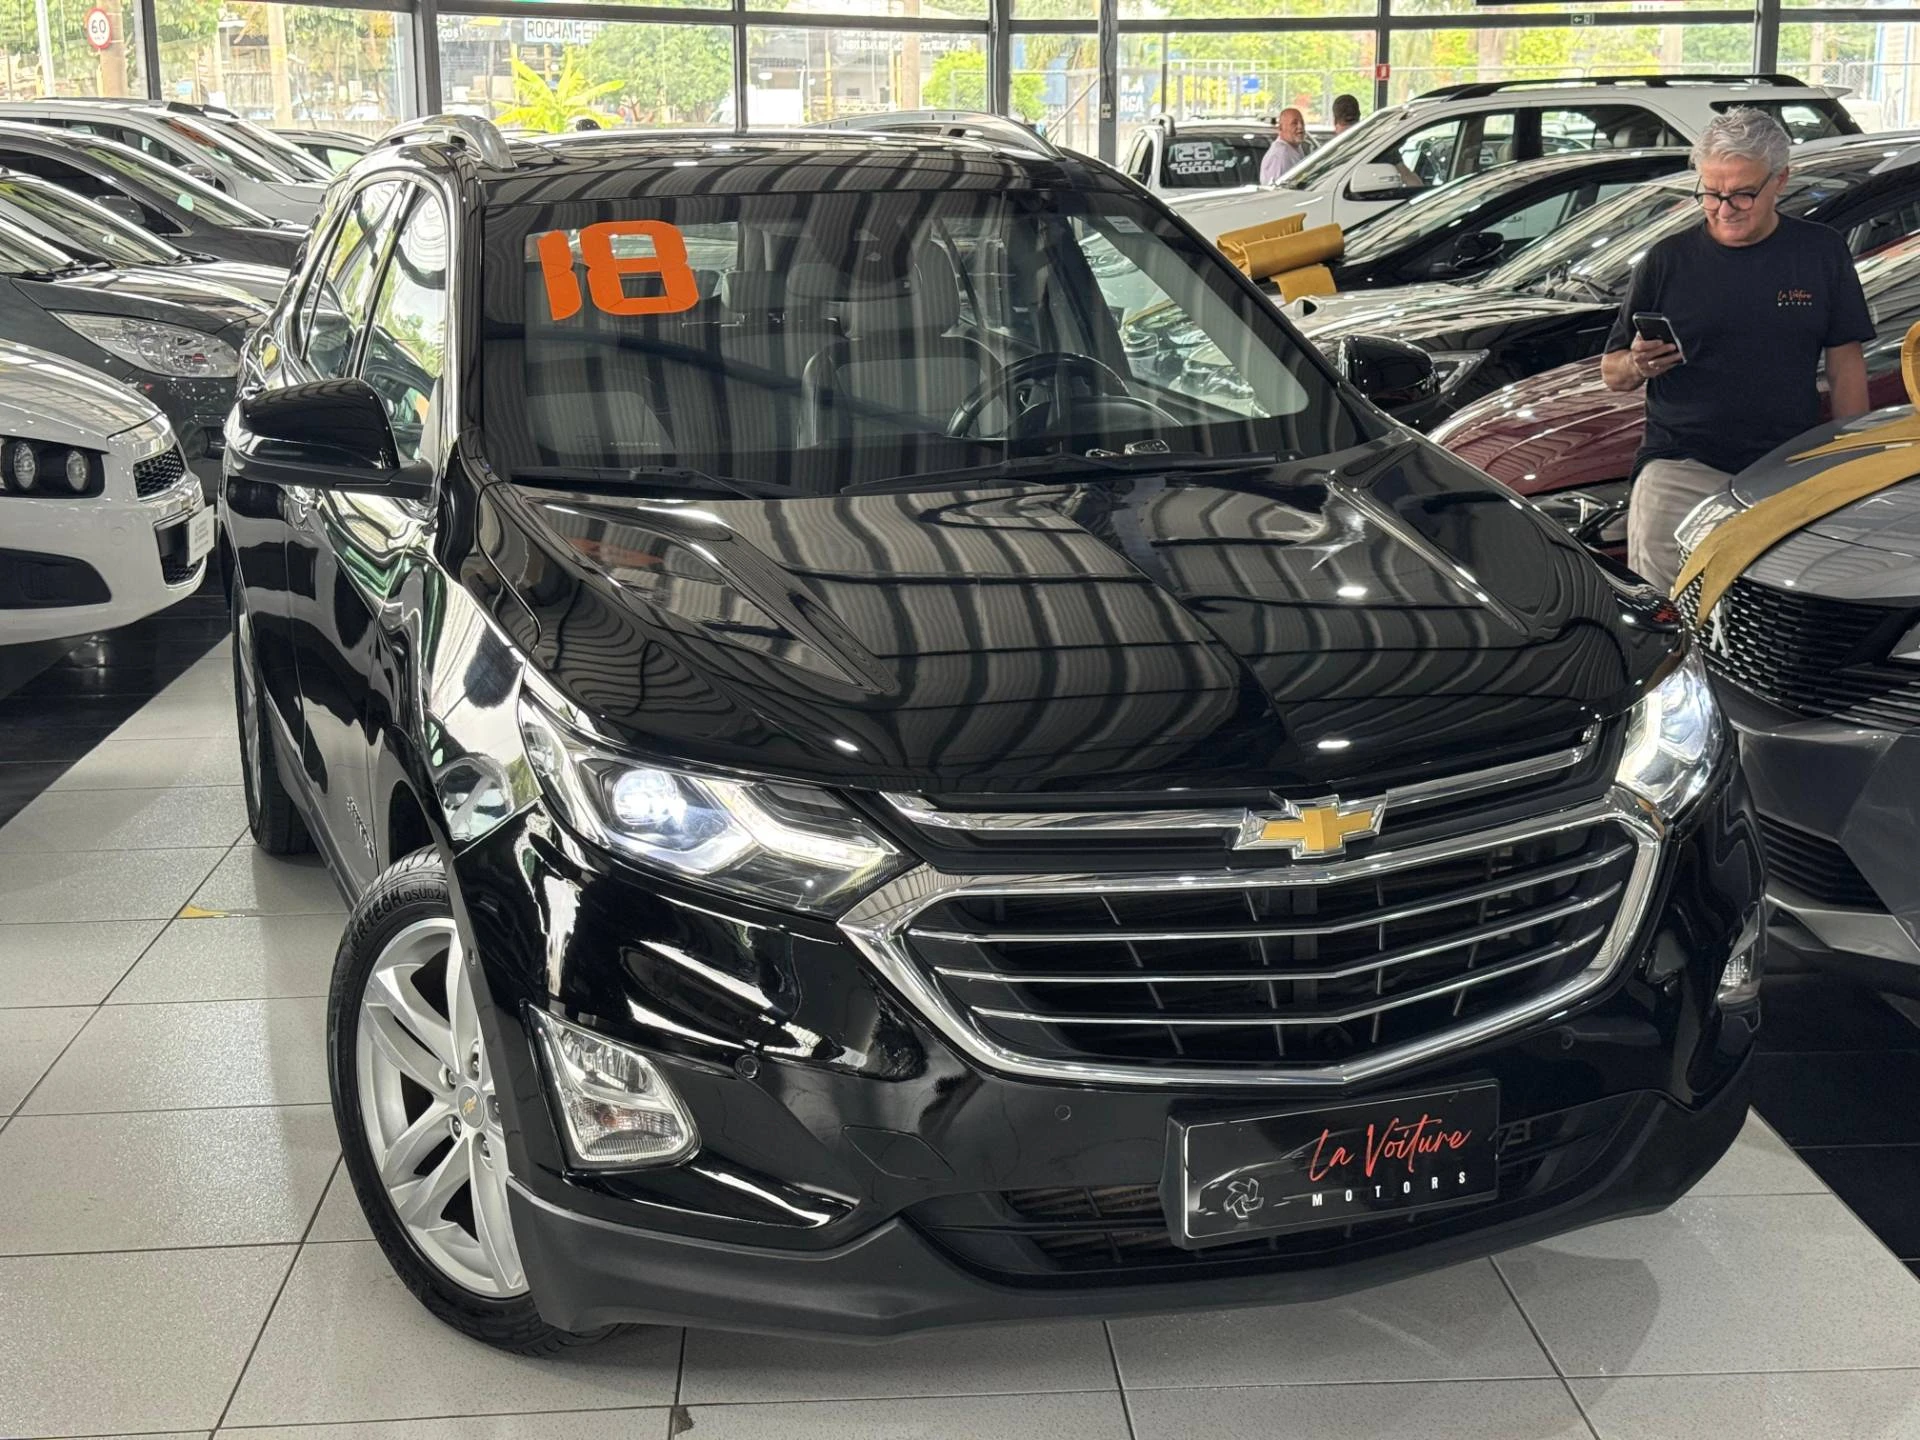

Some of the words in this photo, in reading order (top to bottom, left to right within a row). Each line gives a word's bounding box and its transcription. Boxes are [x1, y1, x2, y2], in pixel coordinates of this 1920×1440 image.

[91, 19, 106, 34] 60
[537, 220, 699, 321] 18
[1309, 1129, 1355, 1181] La
[1362, 1114, 1472, 1178] Voiture
[1311, 1171, 1466, 1207] MOTORS
